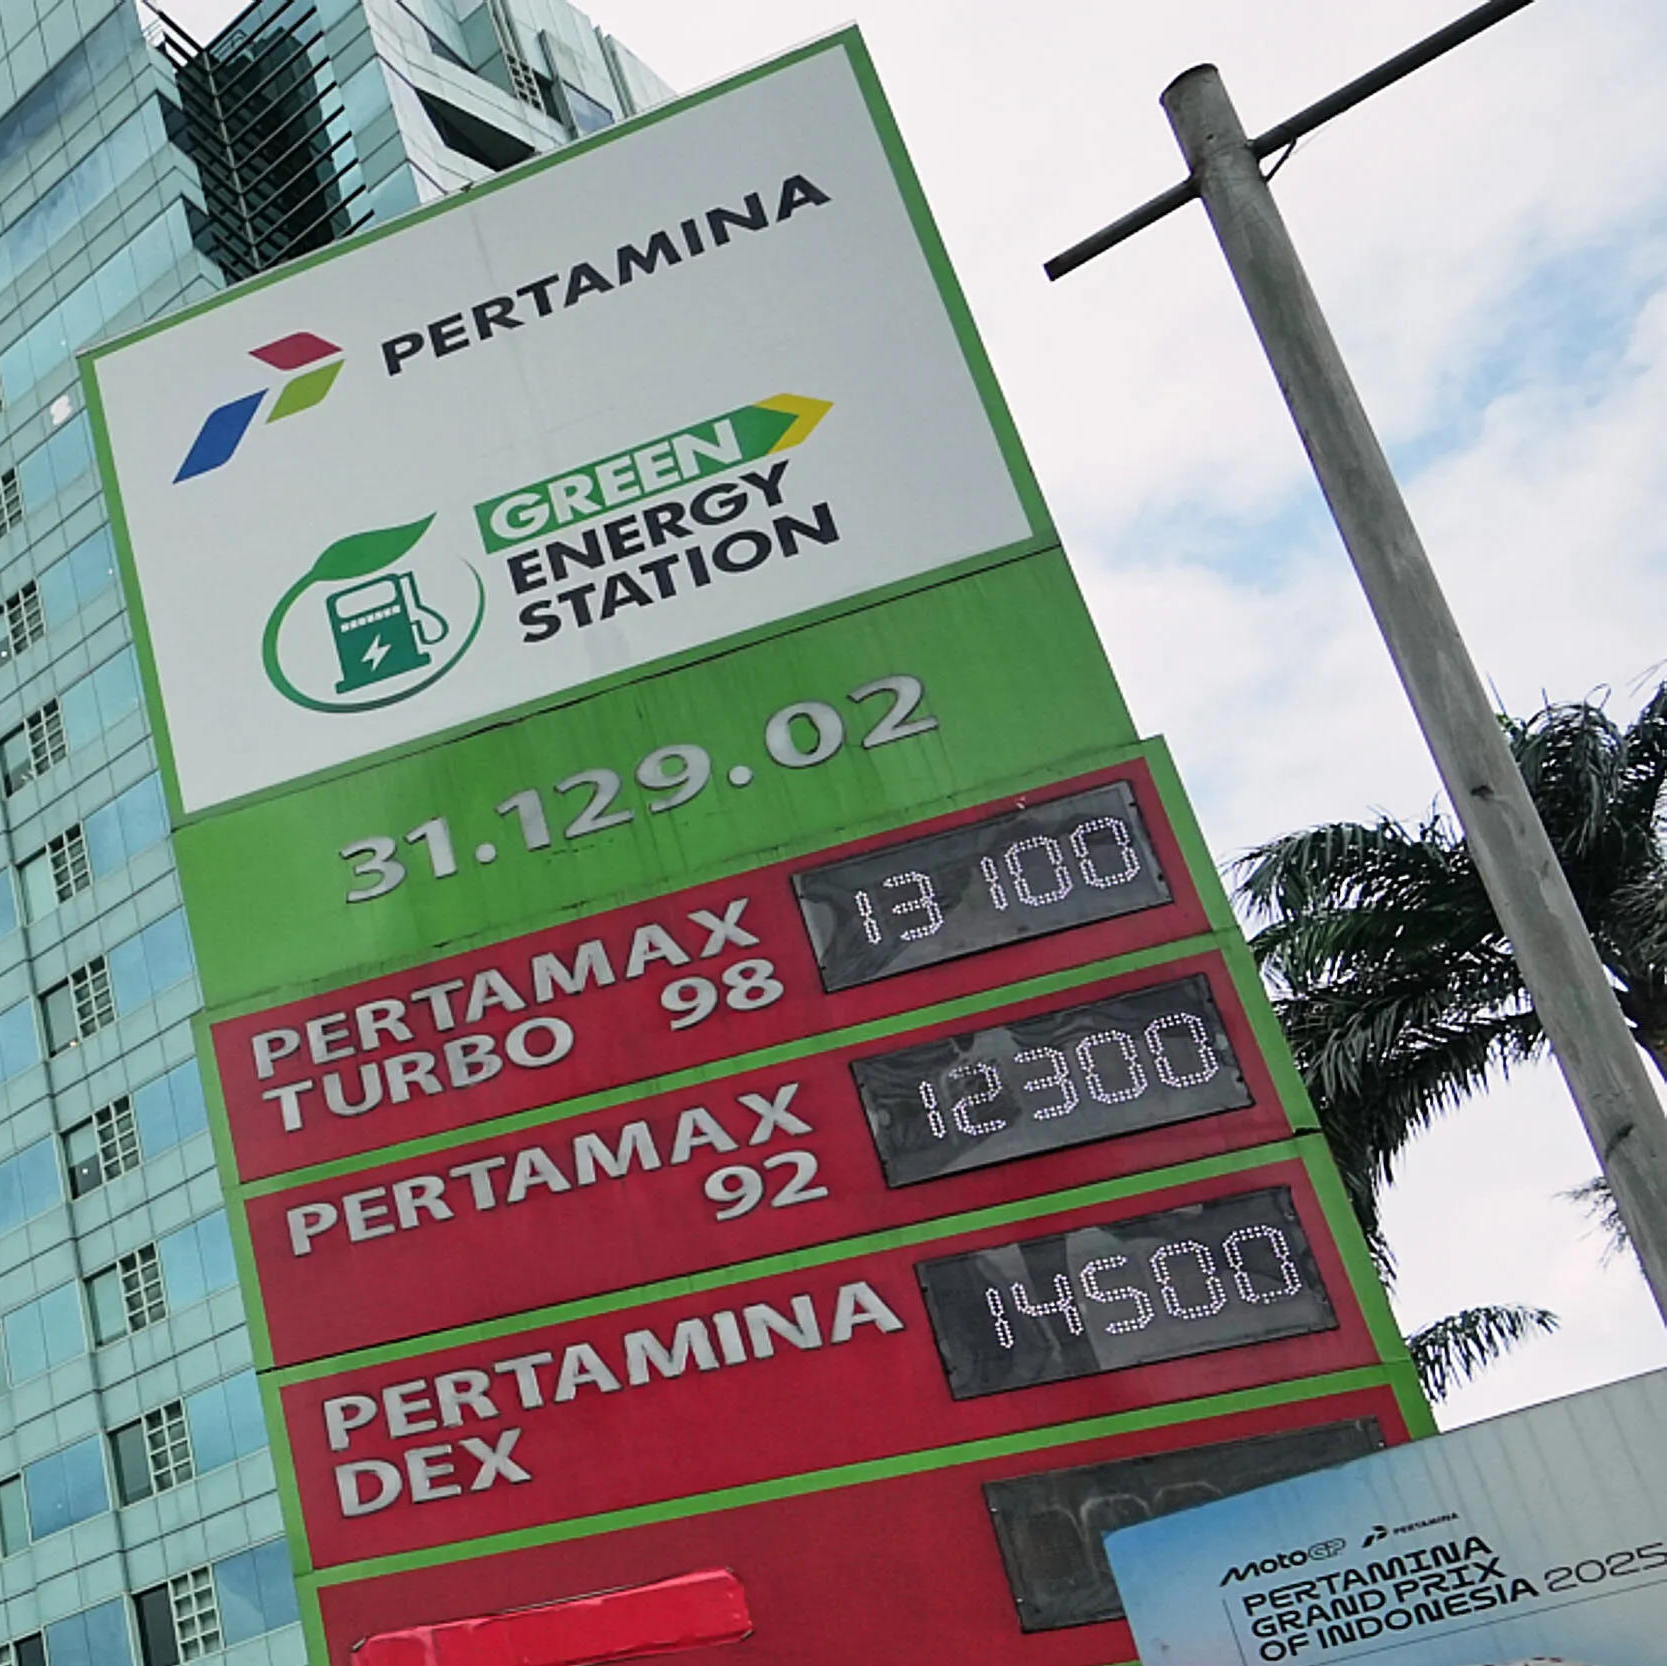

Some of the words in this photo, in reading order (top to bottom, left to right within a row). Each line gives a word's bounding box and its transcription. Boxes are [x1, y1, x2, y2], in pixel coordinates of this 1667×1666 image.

[380, 173, 831, 375] PERTAMINA
[487, 419, 744, 542] GREEN
[506, 460, 793, 594] ENERGY
[518, 502, 841, 643] STATION
[338, 674, 942, 902] 31.129.02
[251, 897, 761, 1080] PERTAMAX
[263, 1015, 575, 1134] TURBO
[661, 957, 785, 1033] 98
[918, 1011, 1220, 1140] 12300
[285, 1083, 814, 1257] PERTAMAX
[703, 1152, 830, 1221] 92
[986, 1223, 1303, 1350] 14500
[321, 1281, 905, 1453] PERTAMINA
[333, 1426, 533, 1518] DEX
[1392, 1512, 1460, 1536] PERTAMINA
[1219, 1538, 1347, 1587] MotoGP
[1243, 1536, 1494, 1617] PERTAMINA
[1252, 1588, 1387, 1638] GRAND
[1395, 1557, 1508, 1604] PRIX
[1259, 1634, 1310, 1662] OF
[1319, 1578, 1540, 1649] INDONESIA
[1544, 1542, 1667, 1593] 2025
